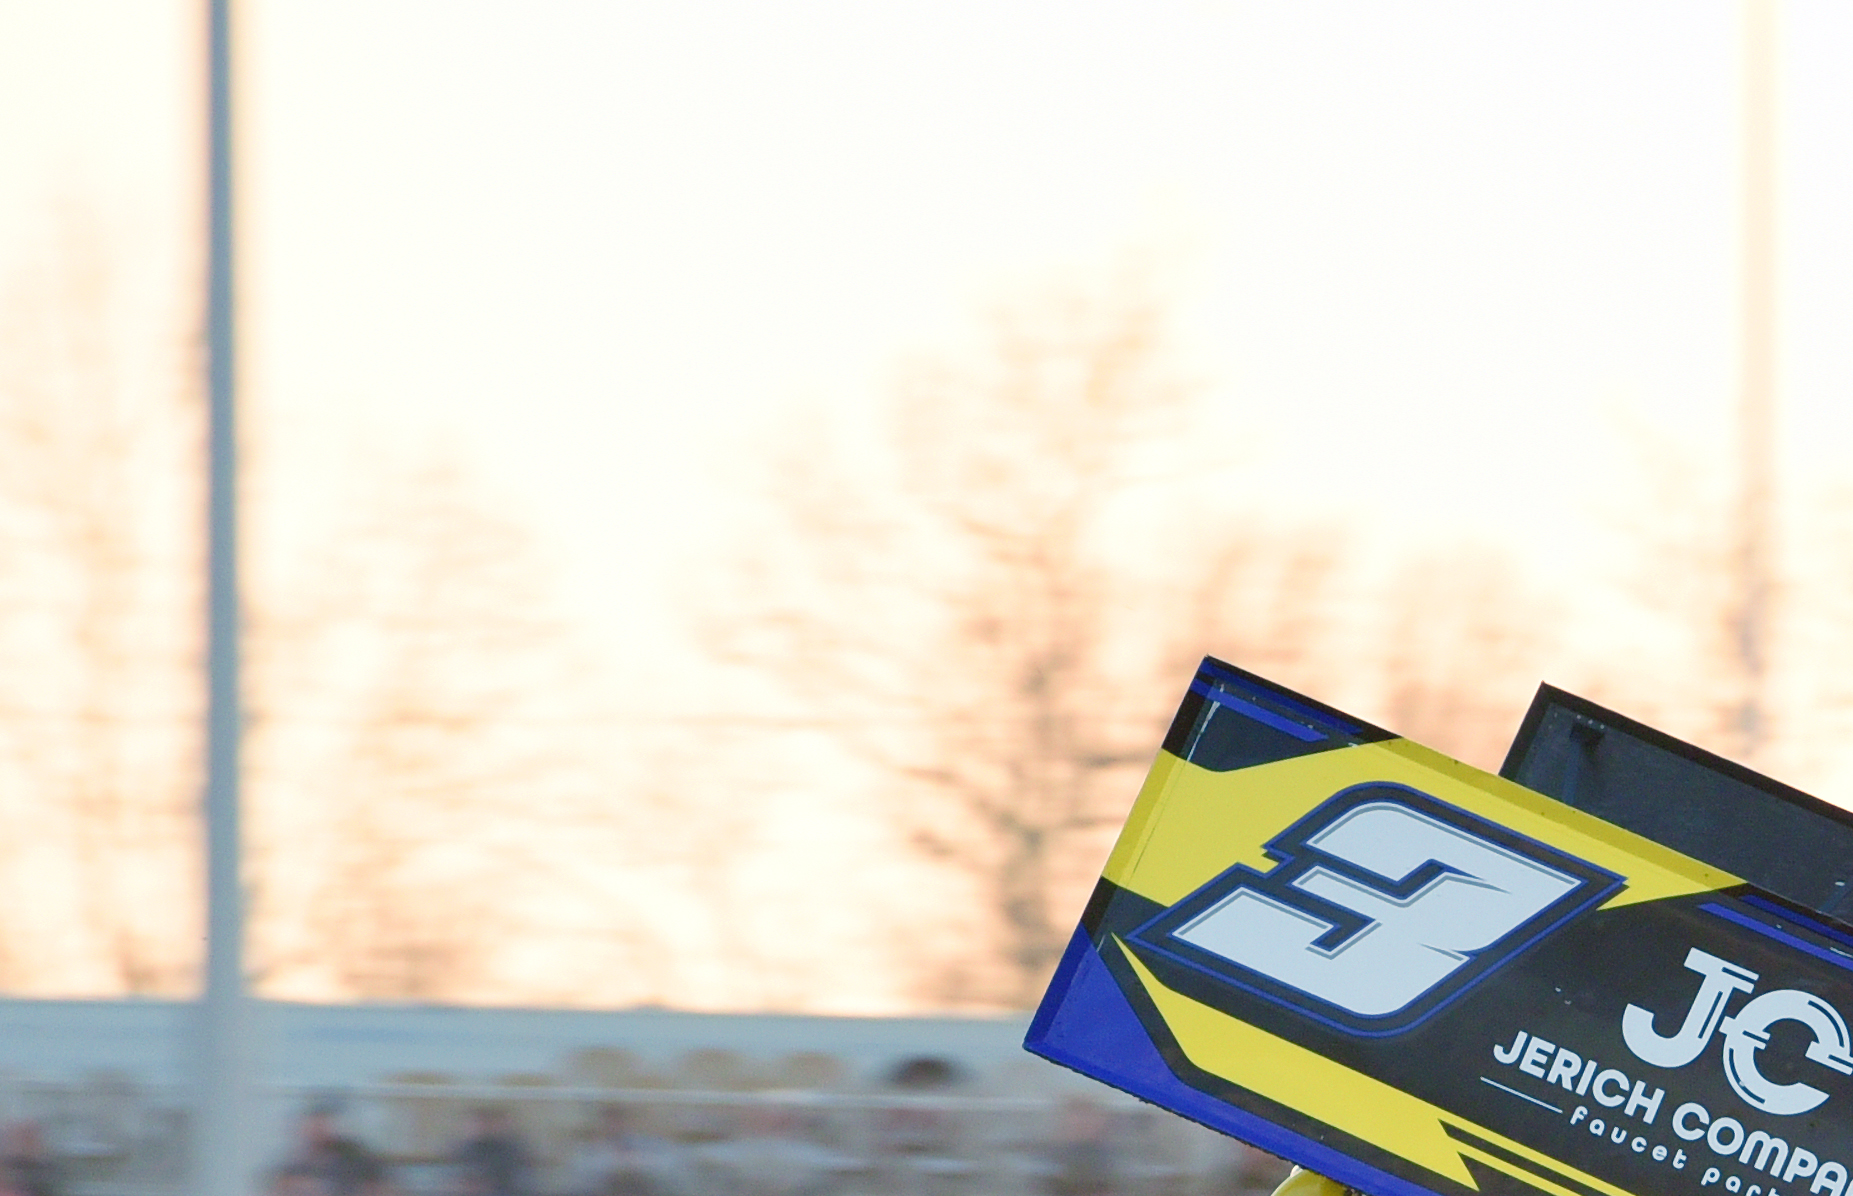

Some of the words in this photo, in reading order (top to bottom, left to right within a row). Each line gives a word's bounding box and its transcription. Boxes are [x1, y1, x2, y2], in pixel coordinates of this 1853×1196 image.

[1170, 800, 1588, 1016] 3
[1493, 1030, 1665, 1124] JERICH
[1569, 1105, 1688, 1169] faucet
